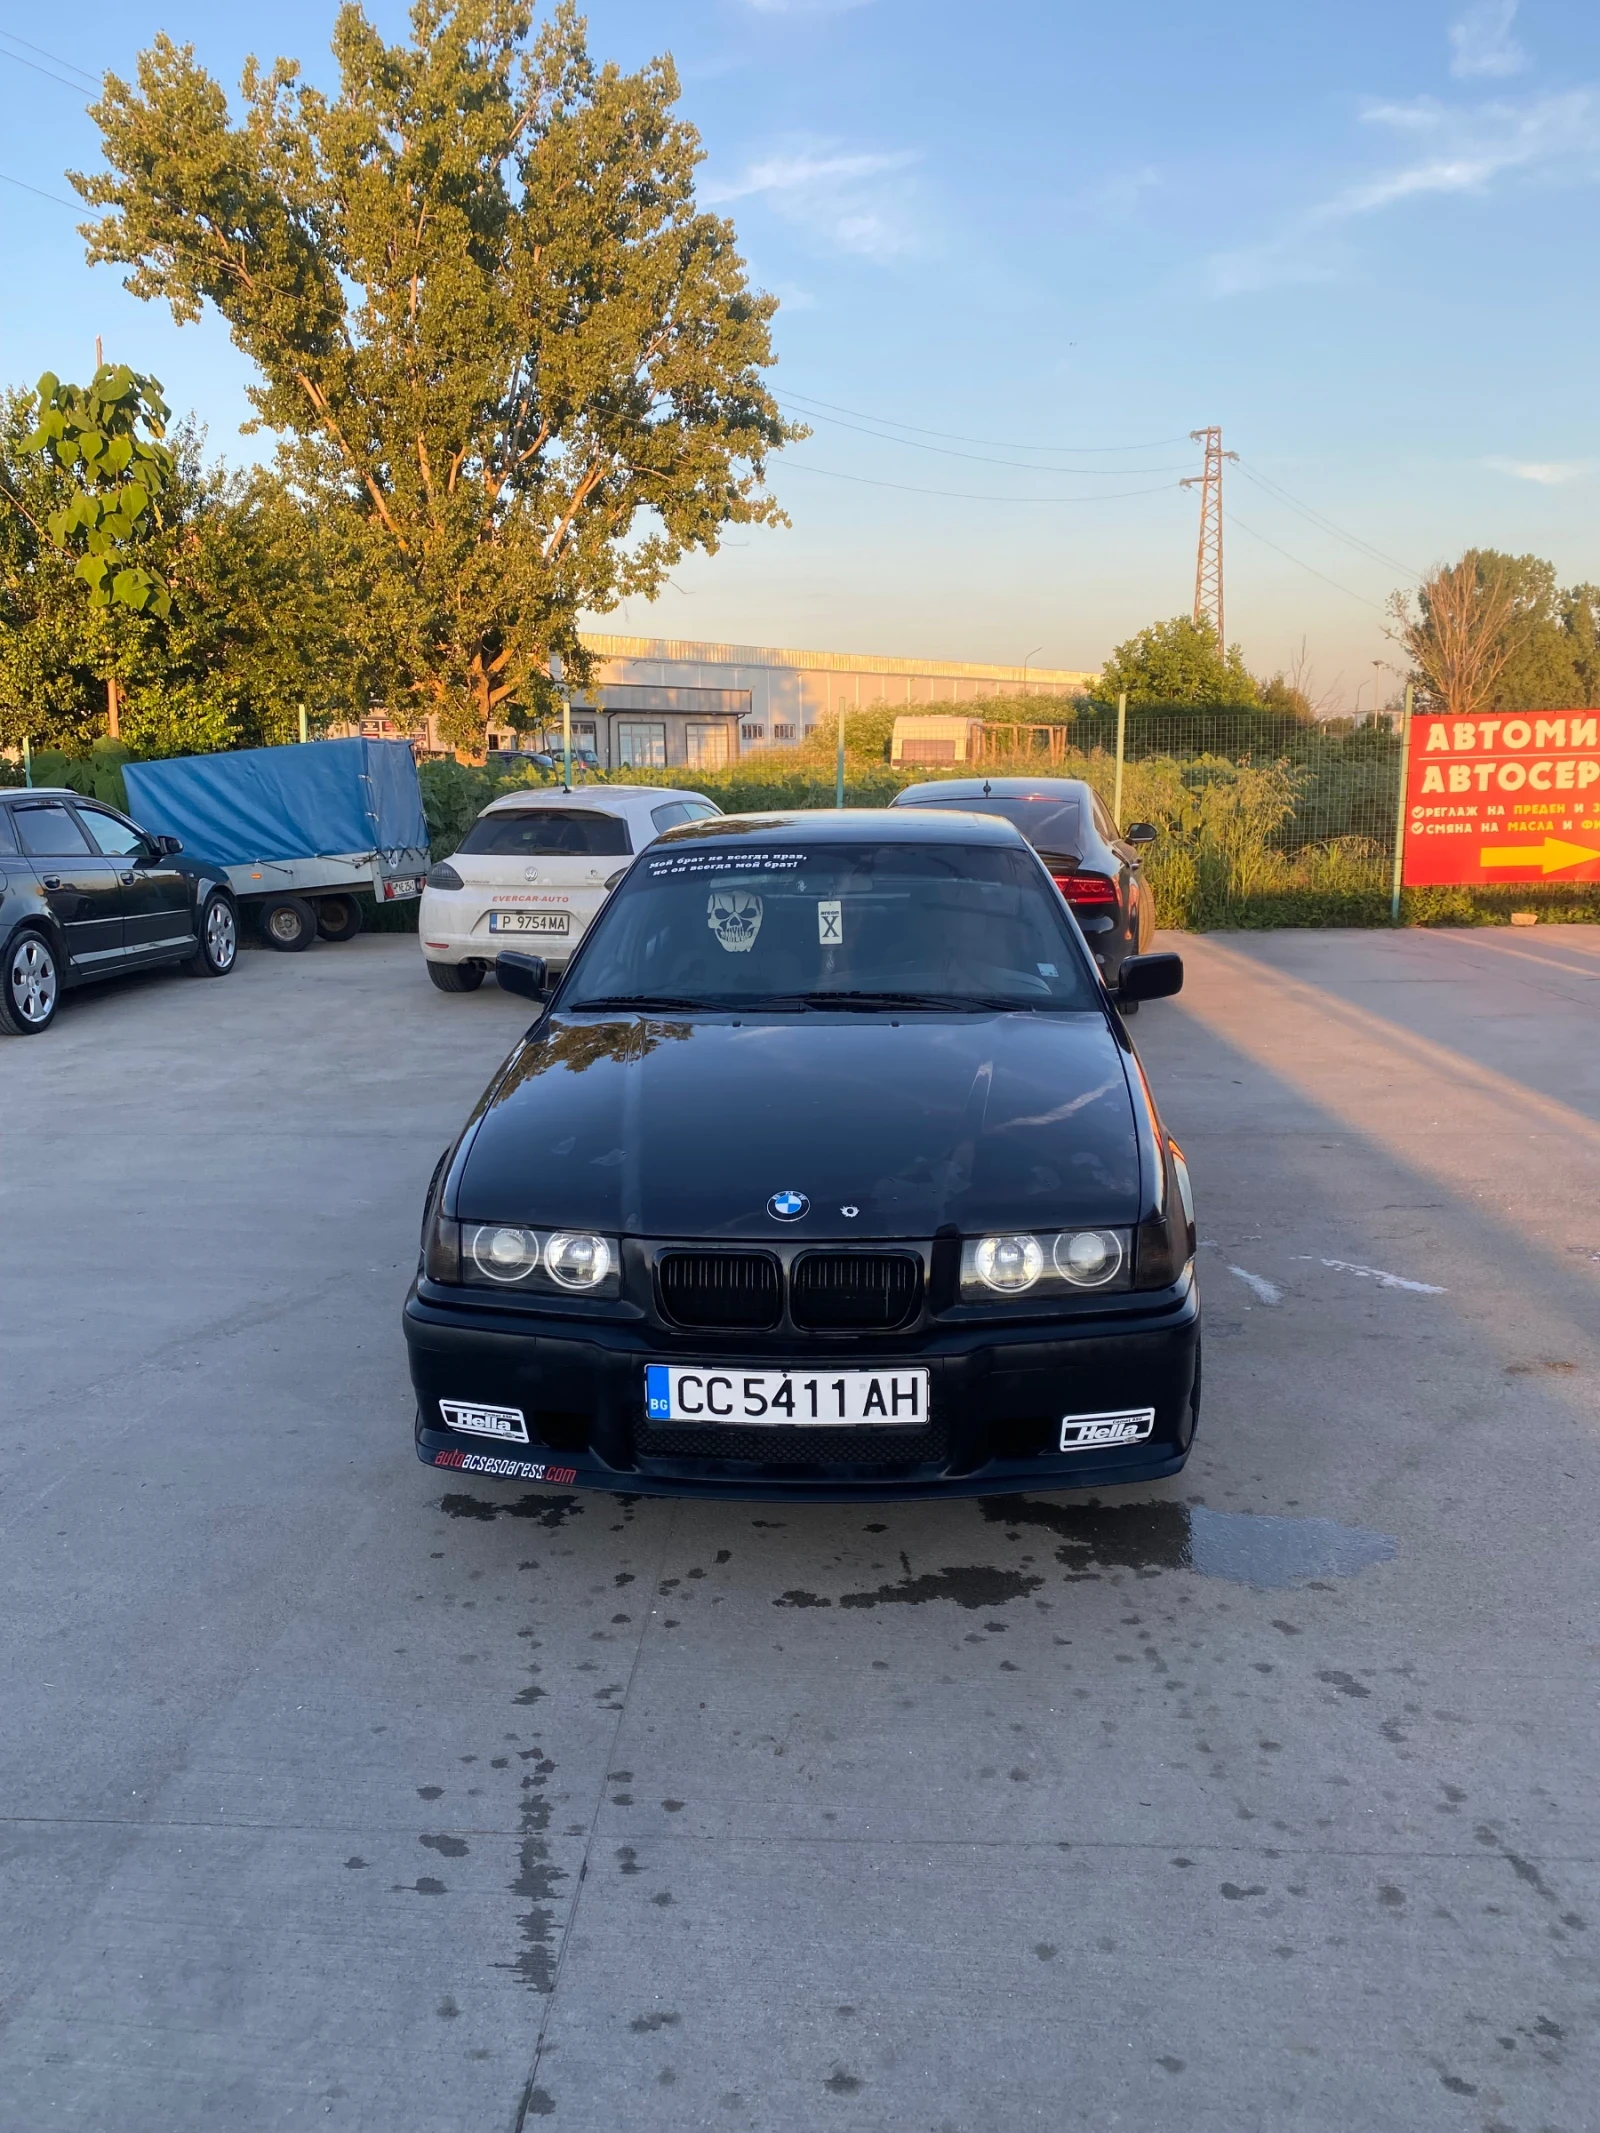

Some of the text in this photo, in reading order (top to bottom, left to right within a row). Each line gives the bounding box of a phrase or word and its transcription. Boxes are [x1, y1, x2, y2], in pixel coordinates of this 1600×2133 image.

[1425, 718, 1598, 752] АВТОМИ
[1420, 760, 1600, 794] АВТОСЕР
[1425, 806, 1478, 818] РЕГЛАЖ
[1487, 805, 1505, 816] НА
[1513, 803, 1566, 815] ПРЕДЕН
[1574, 803, 1584, 813] И
[1426, 823, 1473, 835] СМЯНА
[1481, 822, 1499, 833] НА
[1507, 820, 1554, 832] МАСЛА
[1562, 820, 1573, 831] И
[649, 859, 674, 869] Мой
[677, 855, 705, 865] брат
[727, 853, 768, 861] всегда
[690, 863, 731, 871] всегда
[735, 860, 761, 869] мой
[492, 895, 569, 903] EVERCAR-AUTO
[502, 915, 511, 929] P
[821, 916, 840, 937] X
[650, 1398, 668, 1411] BG
[456, 1412, 511, 1431] Hella
[1077, 1424, 1138, 1440] Hella
